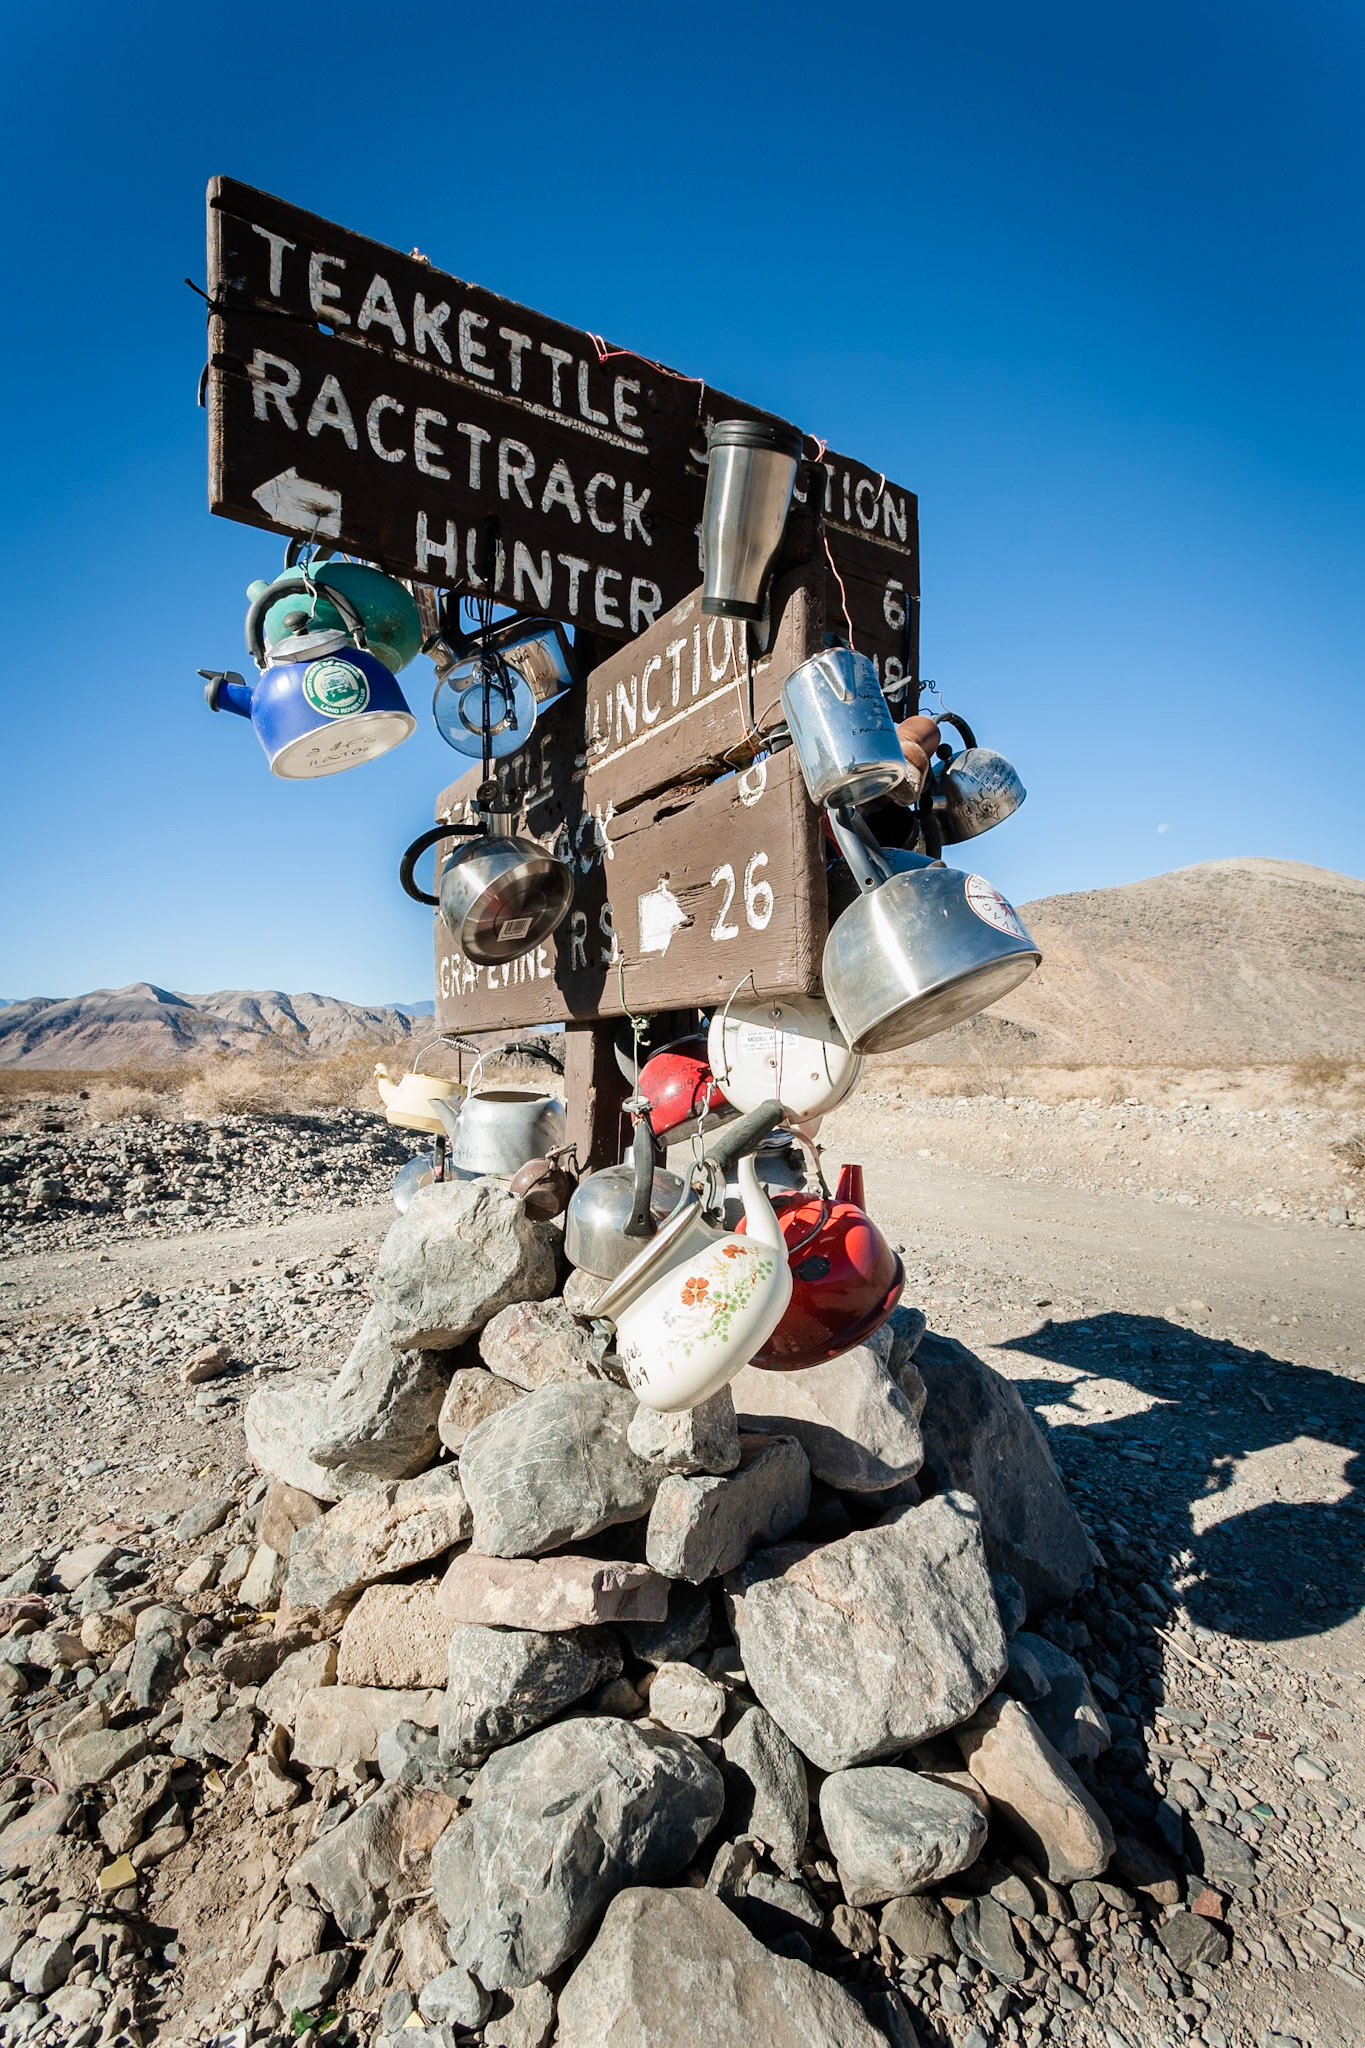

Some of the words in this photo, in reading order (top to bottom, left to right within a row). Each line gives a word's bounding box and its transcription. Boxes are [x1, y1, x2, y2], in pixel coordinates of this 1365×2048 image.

[252, 223, 645, 438] TEAKETTLE
[689, 414, 907, 542] JTION
[247, 349, 653, 547] RACETRACK
[883, 577, 905, 631] 6
[415, 510, 662, 633] HUNTER
[306, 663, 323, 698] NORTHERN
[319, 703, 339, 714] LAND
[340, 703, 360, 714] ROVER
[357, 688, 366, 703] CLUB
[710, 851, 774, 941] 26
